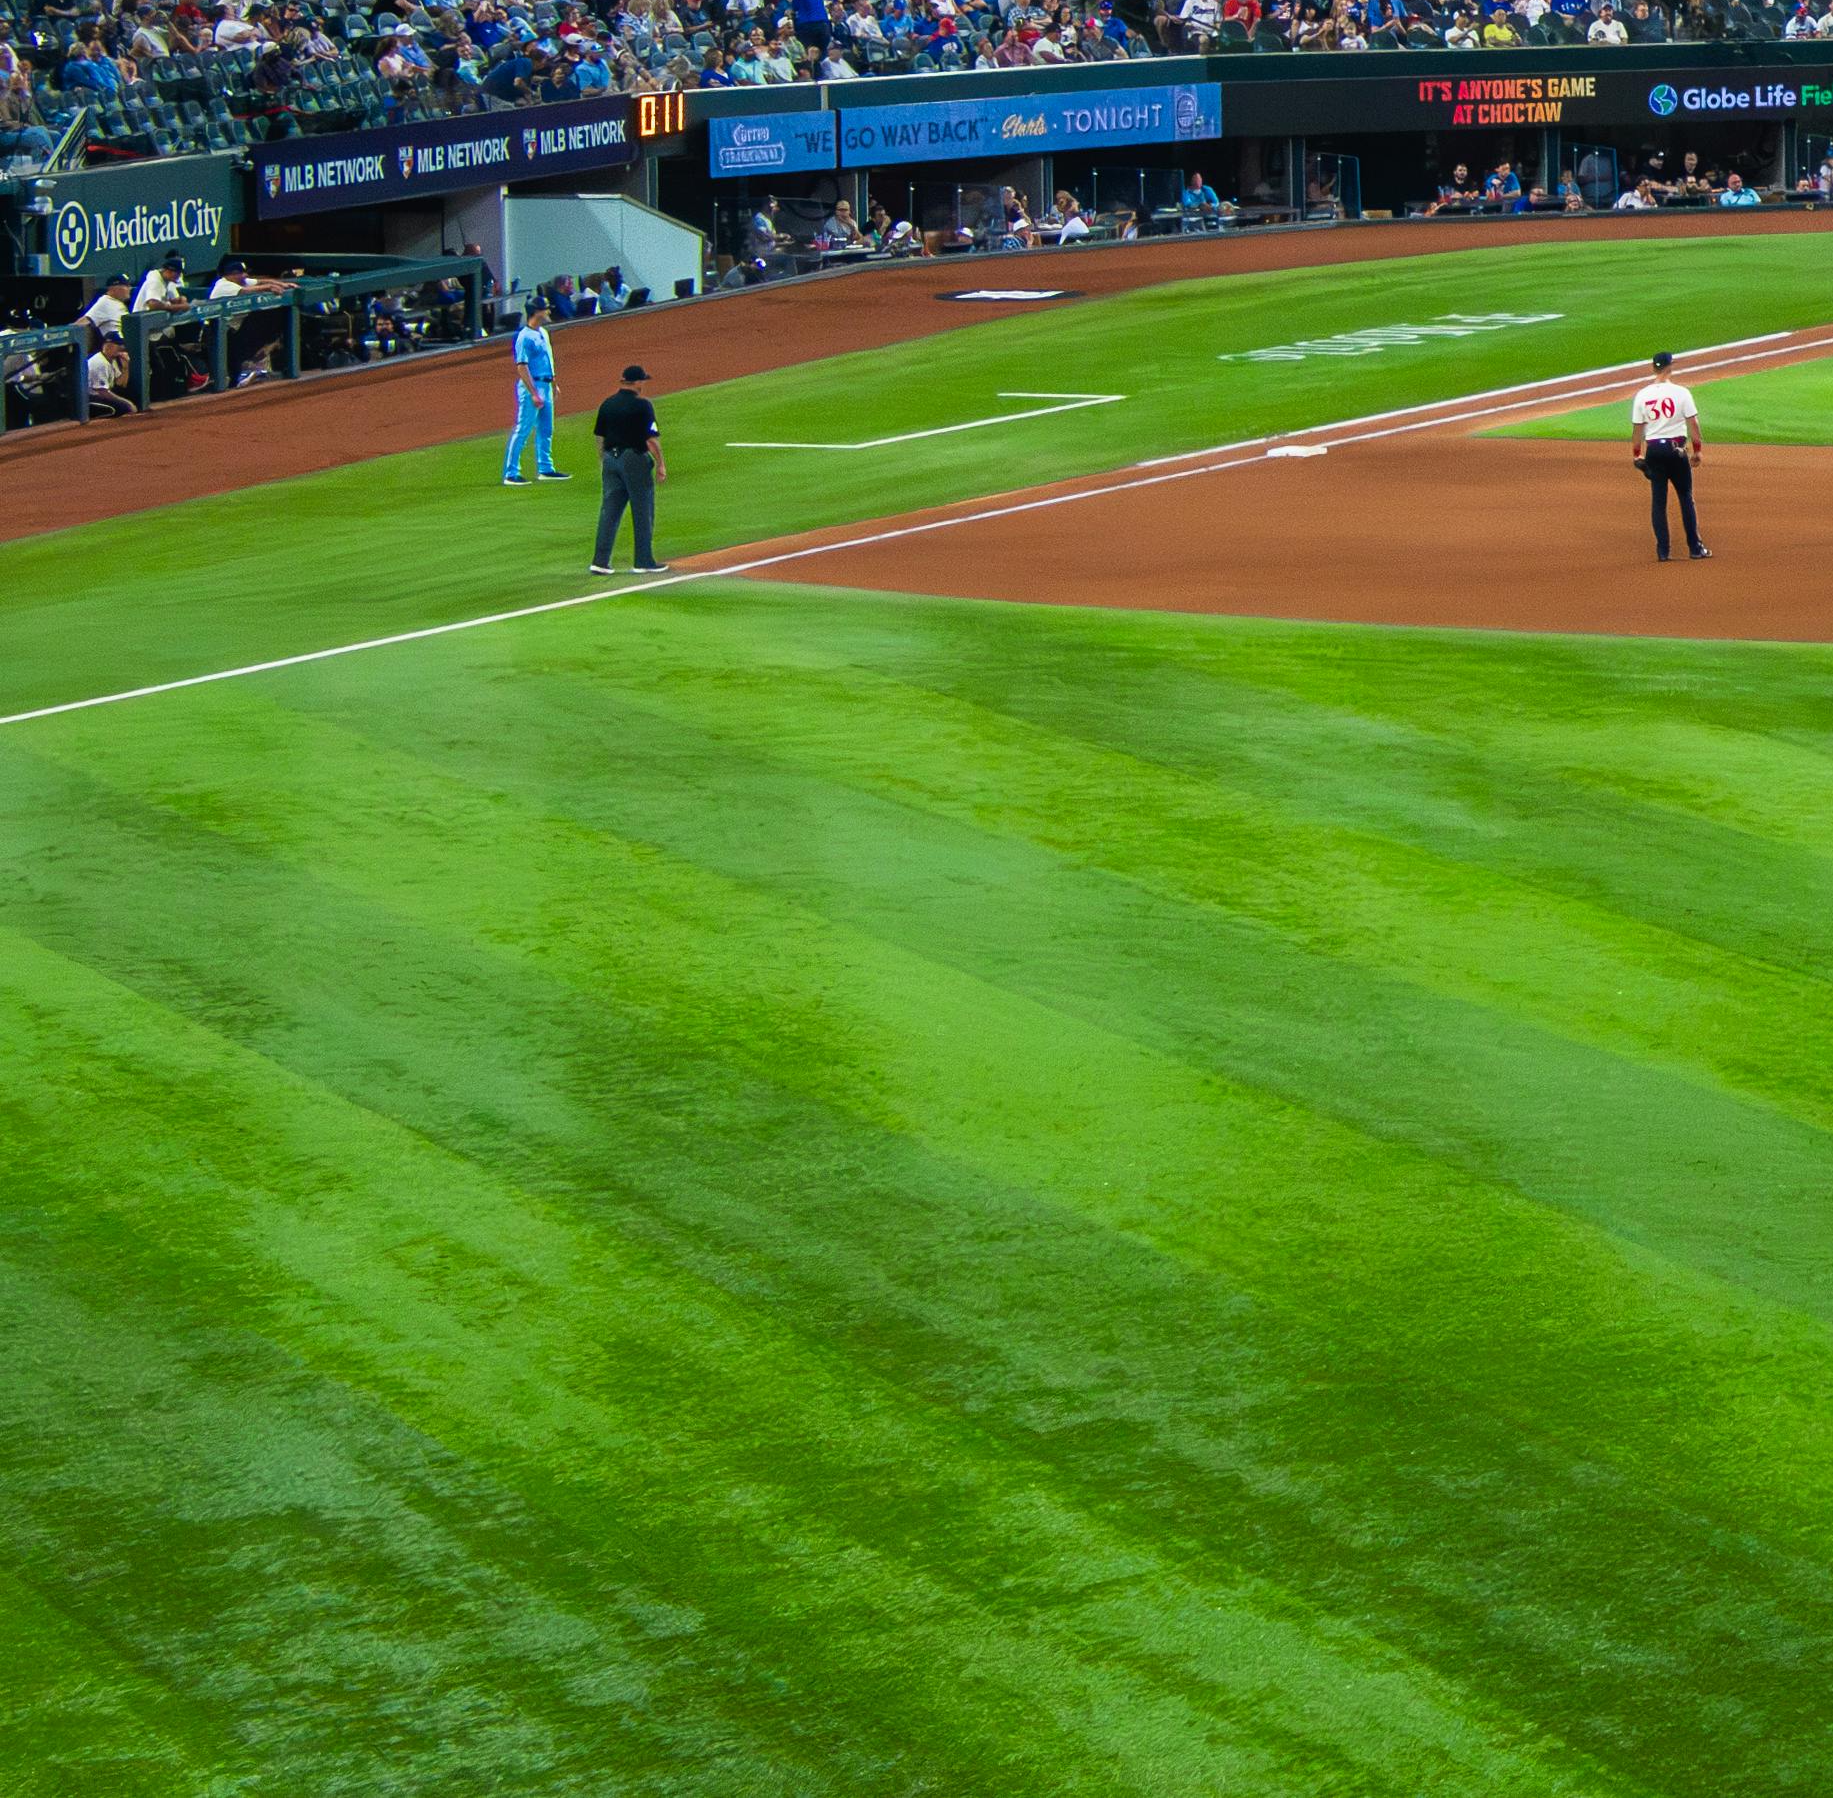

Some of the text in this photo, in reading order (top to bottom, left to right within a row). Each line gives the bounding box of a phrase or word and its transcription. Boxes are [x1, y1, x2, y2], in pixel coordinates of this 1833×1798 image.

[1418, 77, 1596, 102] IT'S ANYONE'S GAME
[1683, 87, 1750, 110] Globe
[1755, 84, 1797, 108] Life
[845, 127, 875, 150] GO
[881, 123, 922, 146] WAY
[1062, 103, 1162, 134] TONIGHT
[1453, 102, 1562, 126] AT CHOCTAW
[417, 146, 444, 173] MLB
[448, 137, 510, 168] NETWORK
[541, 131, 566, 155] MLB
[569, 120, 626, 150] NETWORK
[285, 164, 315, 192] MLB
[318, 155, 385, 188] NETWORK
[94, 198, 223, 252] Medical City
[1645, 397, 1676, 420] 30
